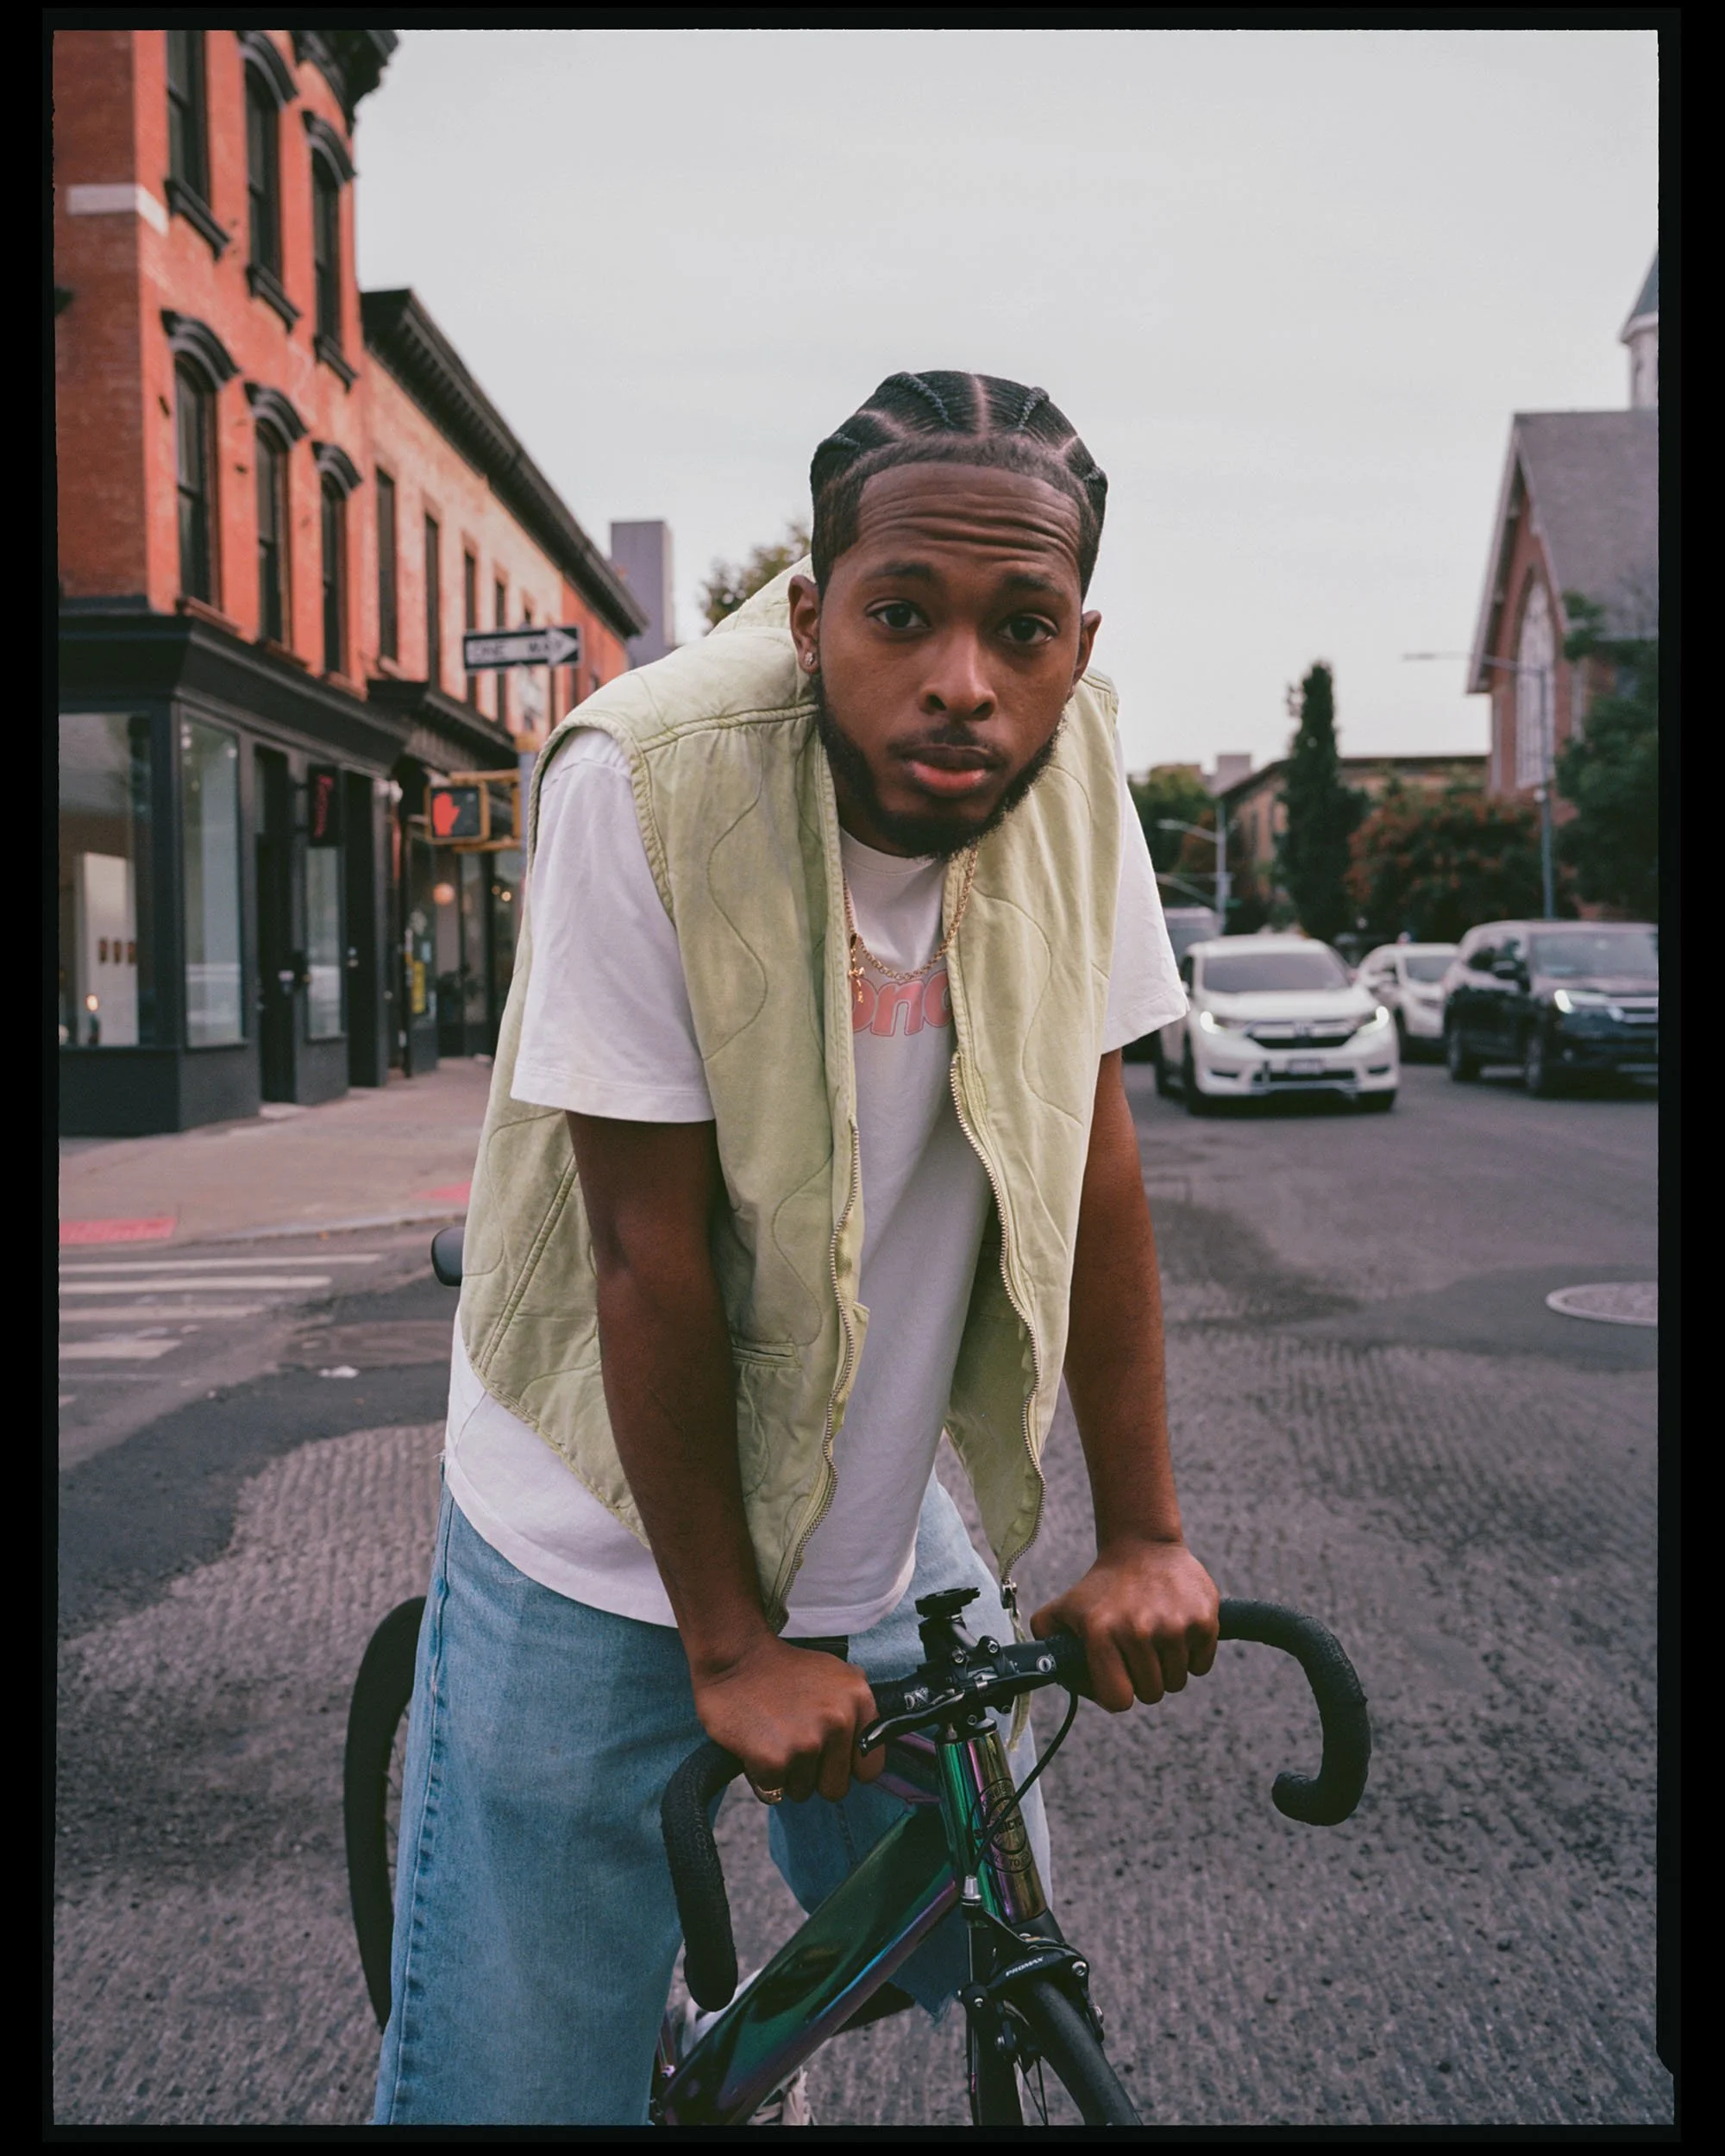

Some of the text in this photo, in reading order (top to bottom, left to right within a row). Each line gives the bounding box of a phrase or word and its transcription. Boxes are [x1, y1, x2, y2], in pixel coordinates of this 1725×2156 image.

[471, 639, 563, 661] ONE WAY
[1005, 1955, 1044, 1977] PROMAX
